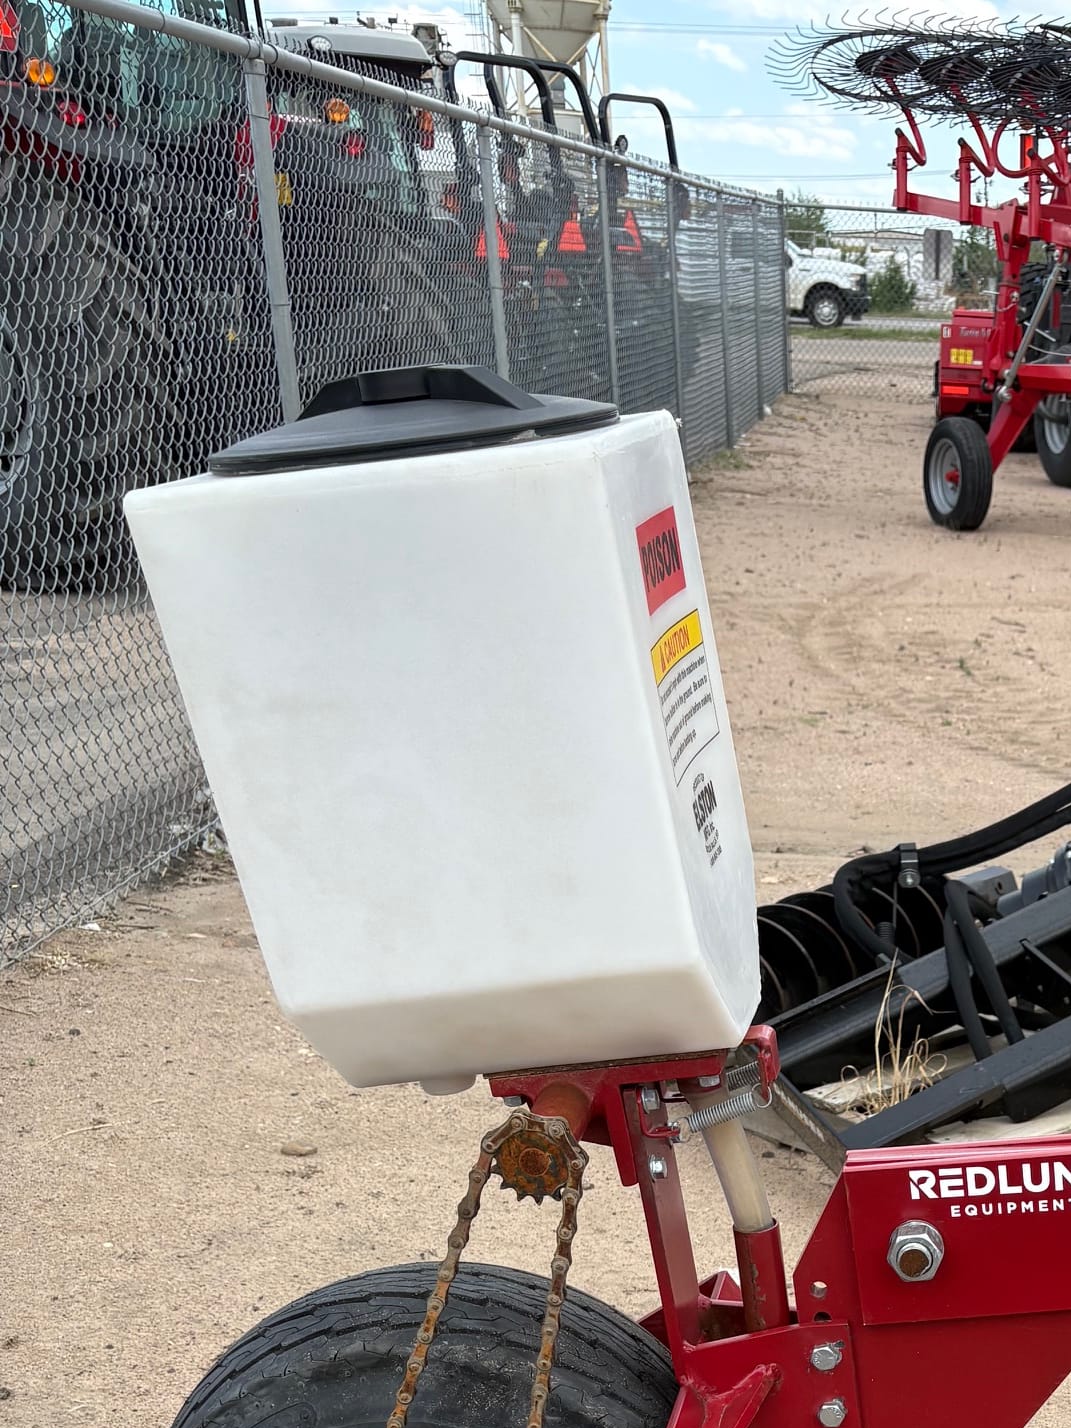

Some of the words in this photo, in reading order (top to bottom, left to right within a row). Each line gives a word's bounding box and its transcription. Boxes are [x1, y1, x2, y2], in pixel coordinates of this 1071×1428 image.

[641, 528, 680, 592] POISON
[664, 624, 690, 662] CAUTION
[693, 780, 717, 832] ELSTON
